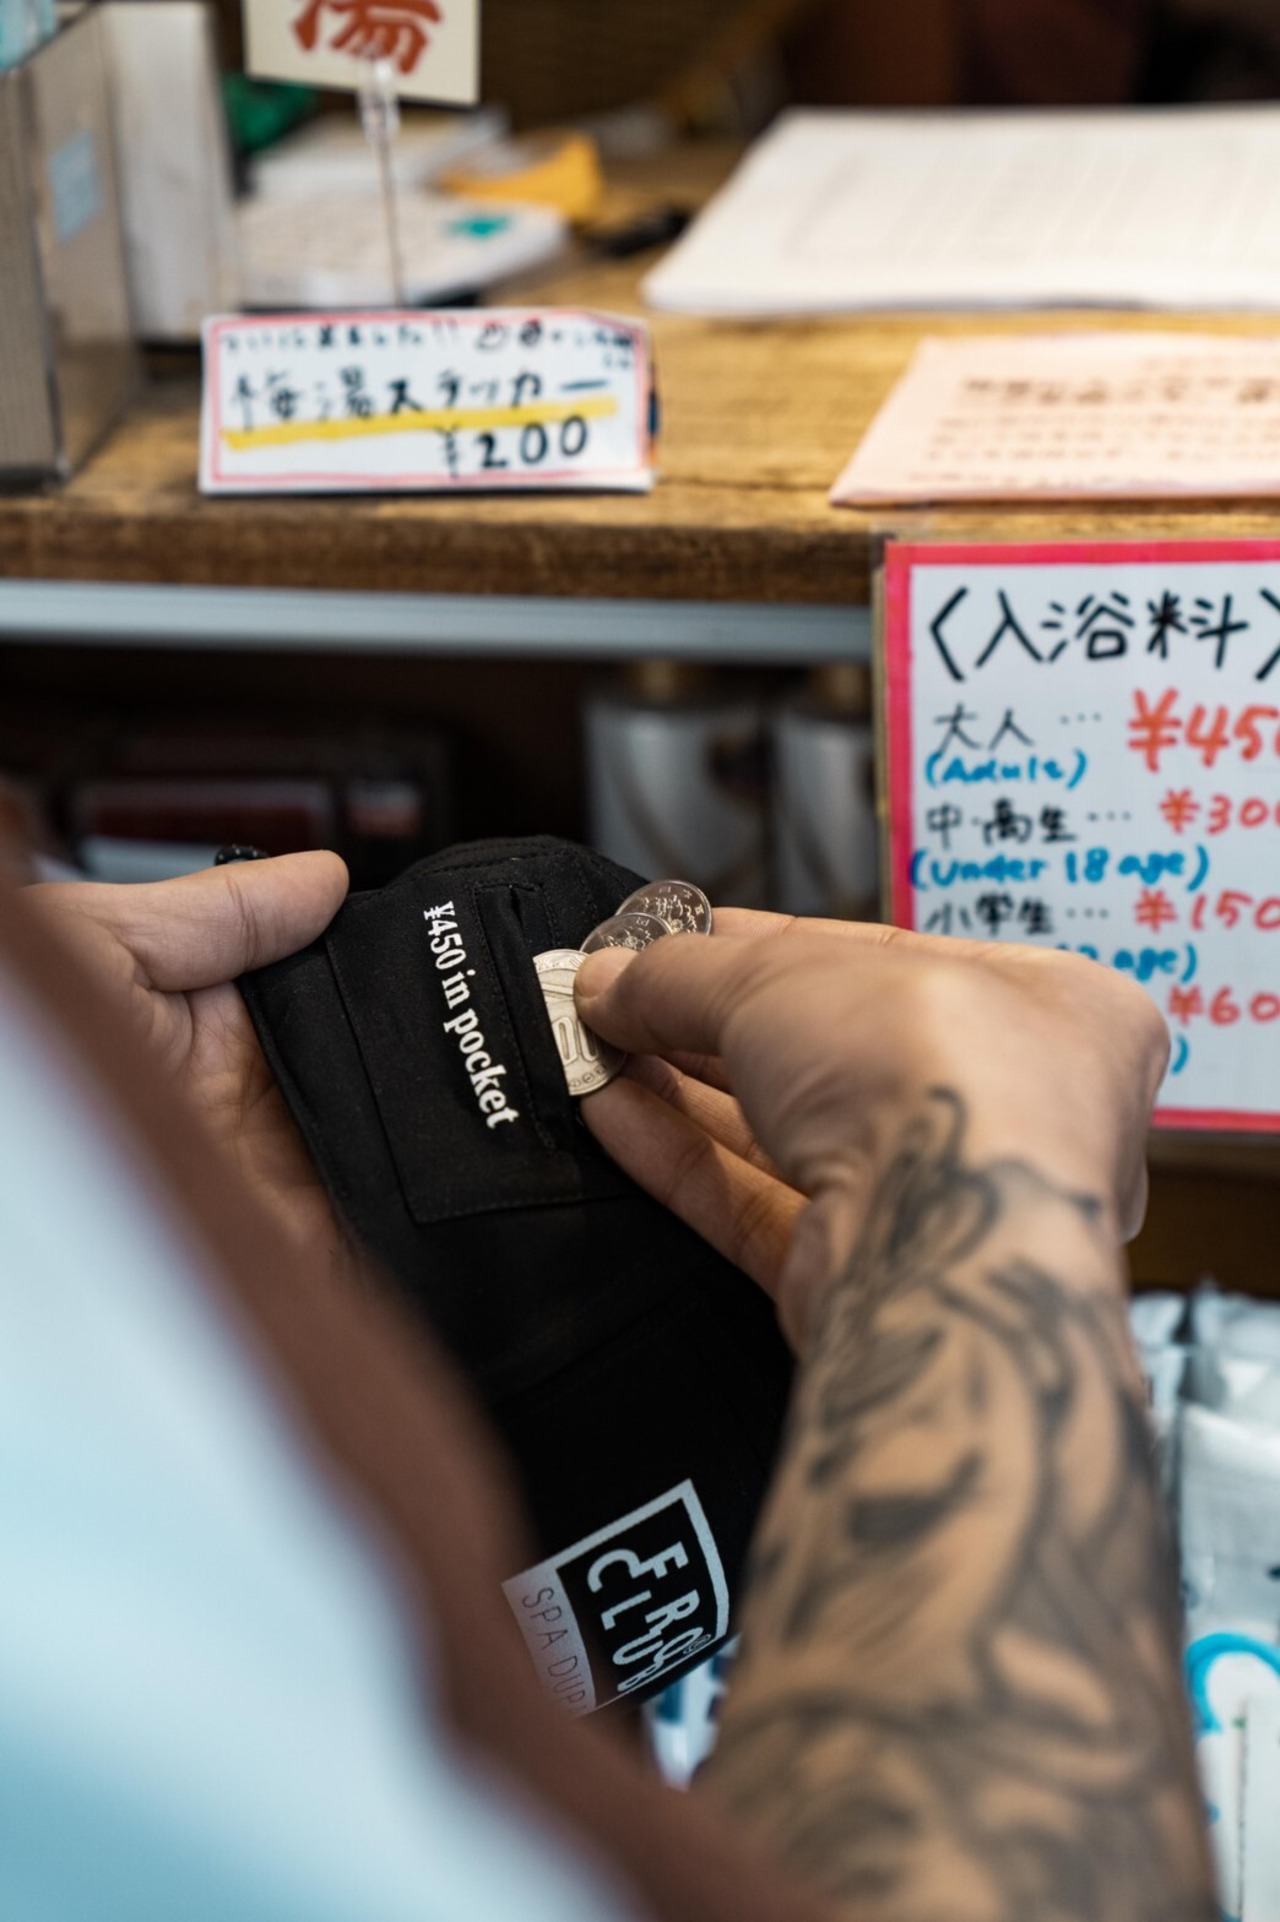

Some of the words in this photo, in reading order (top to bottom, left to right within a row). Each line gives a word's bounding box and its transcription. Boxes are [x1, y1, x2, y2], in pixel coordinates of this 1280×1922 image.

[1127, 687, 1280, 774] ¥45
[1159, 786, 1280, 835] ¥30
[1064, 846, 1110, 884] 18
[423, 900, 467, 970] ¥450
[441, 969, 476, 1009] in
[443, 1008, 519, 1129] pocket
[521, 1587, 569, 1650] SPA
